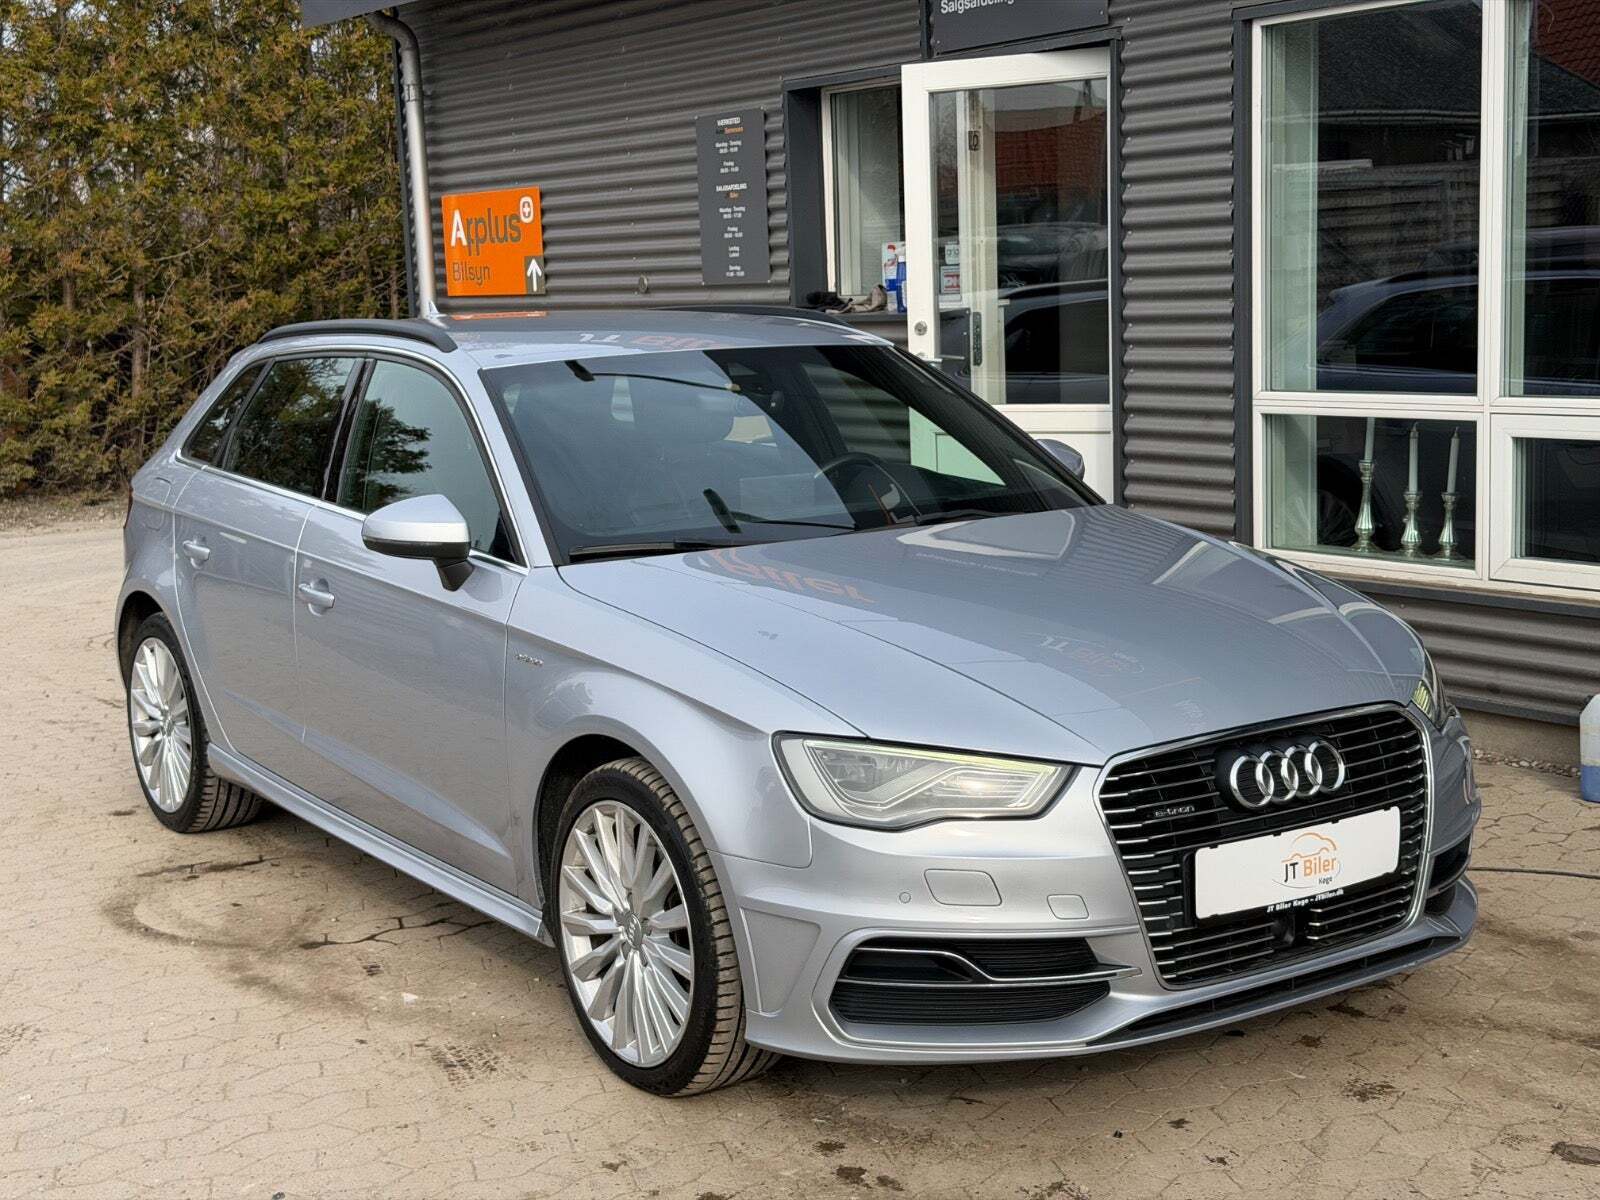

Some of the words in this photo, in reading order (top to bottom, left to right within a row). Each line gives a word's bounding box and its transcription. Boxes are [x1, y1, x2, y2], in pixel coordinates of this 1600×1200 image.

[452, 261, 491, 287] Bilsyn
[1283, 861, 1299, 883] JT
[1303, 857, 1337, 877] Biler
